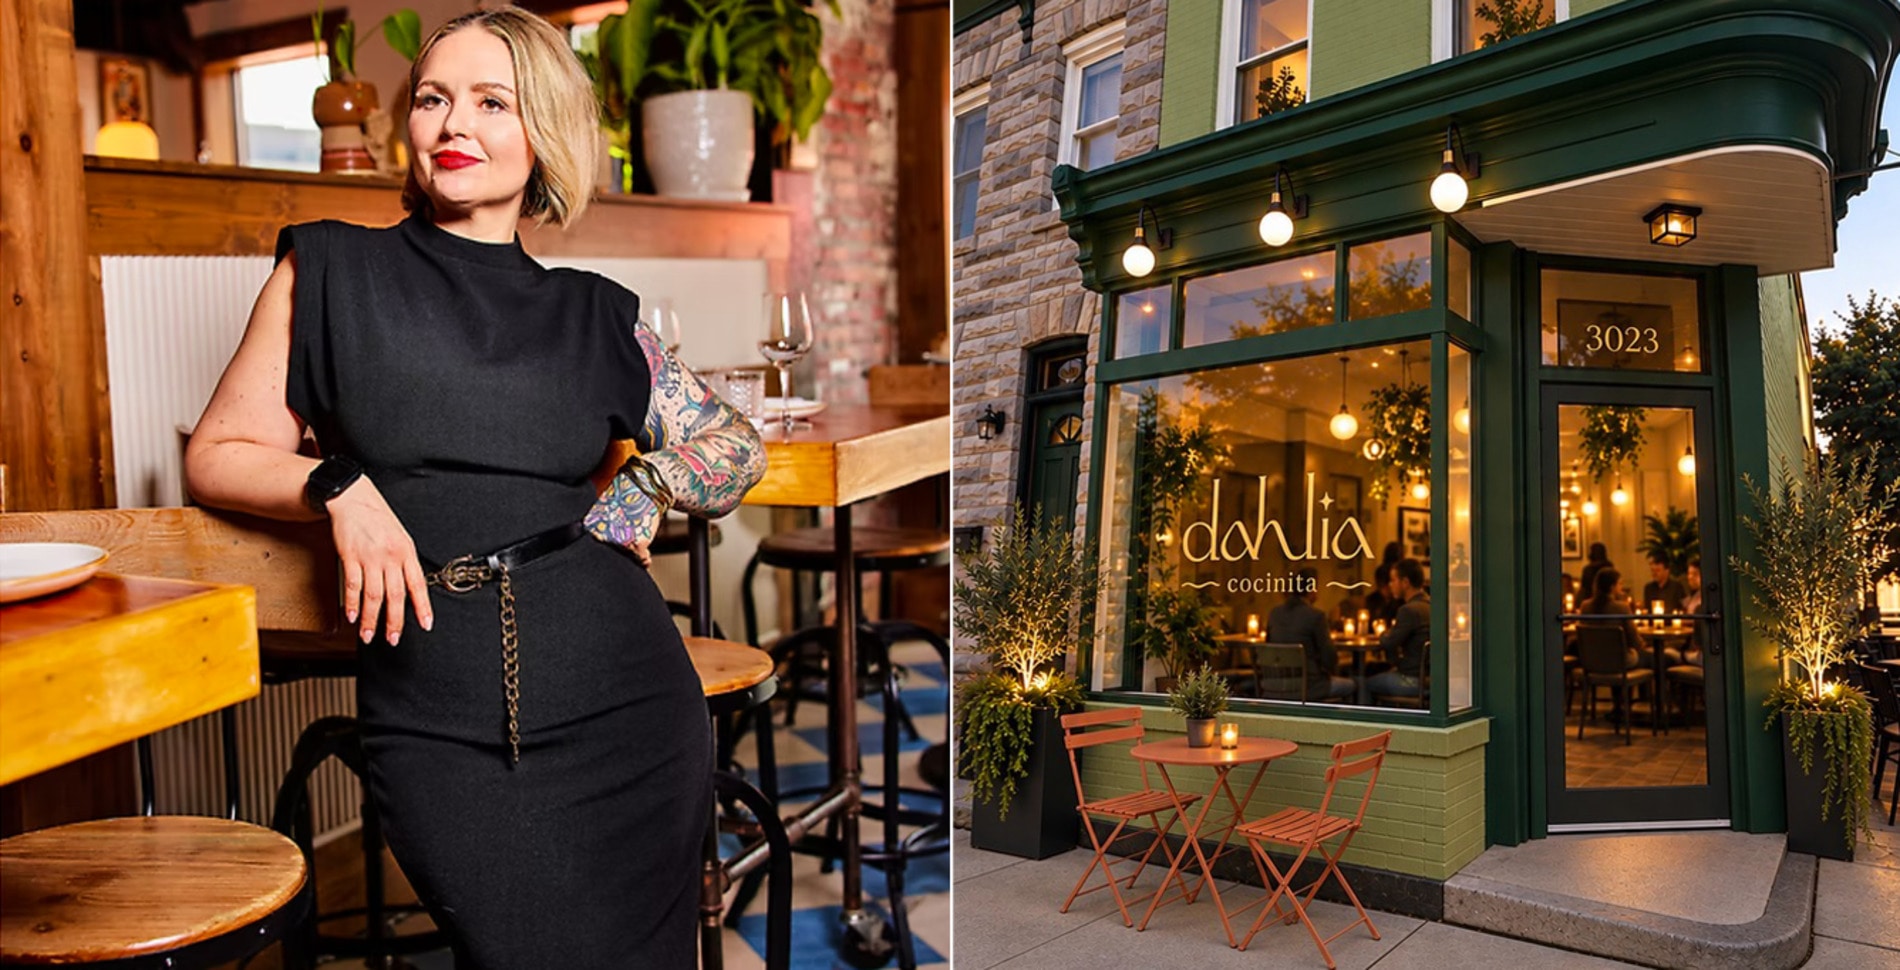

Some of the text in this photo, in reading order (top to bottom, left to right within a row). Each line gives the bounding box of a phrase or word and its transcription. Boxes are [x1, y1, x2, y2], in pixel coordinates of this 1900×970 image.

[1586, 324, 1660, 354] 3023
[1182, 472, 1375, 562] dahlia
[1227, 571, 1318, 593] cocinita
